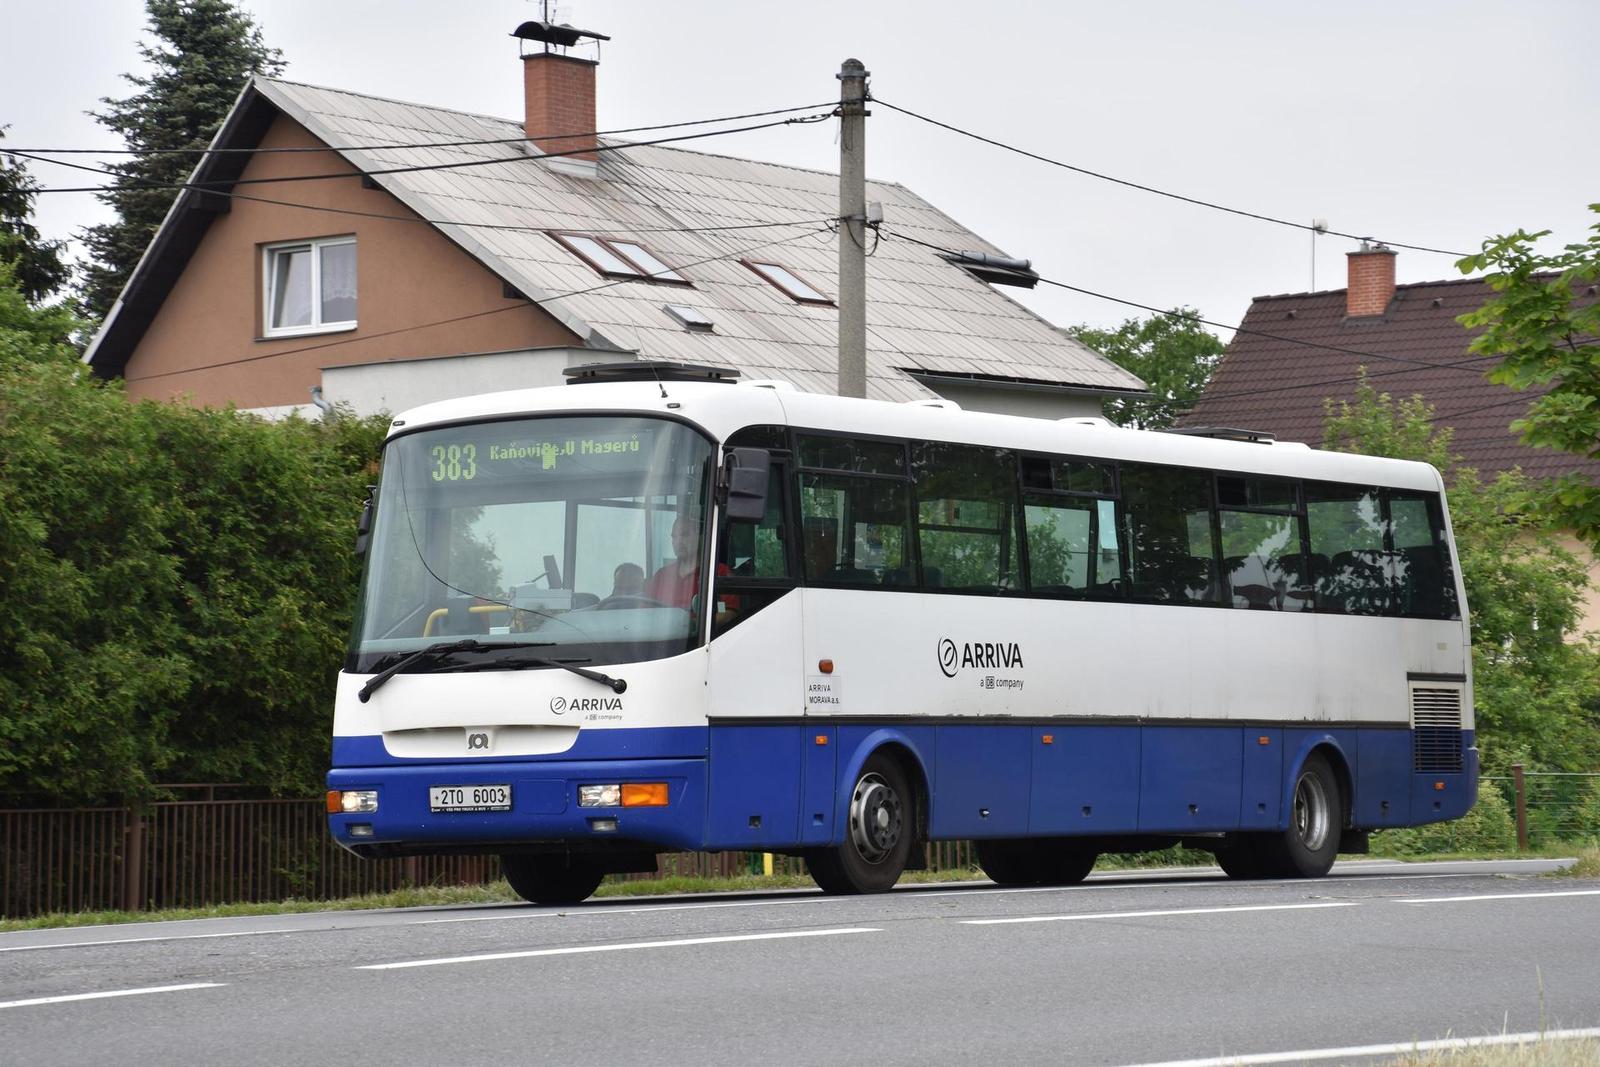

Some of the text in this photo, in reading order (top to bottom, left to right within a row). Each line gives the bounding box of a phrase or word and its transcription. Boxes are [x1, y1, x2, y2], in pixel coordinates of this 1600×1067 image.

[581, 433, 640, 456] Magerů
[432, 443, 477, 481] 383
[961, 642, 1024, 668] ARRIVA
[808, 684, 831, 692] ARRIVA
[985, 676, 995, 689] DB
[996, 679, 1024, 690] company
[569, 698, 623, 711] ARRIVA
[473, 788, 505, 804] 6003
